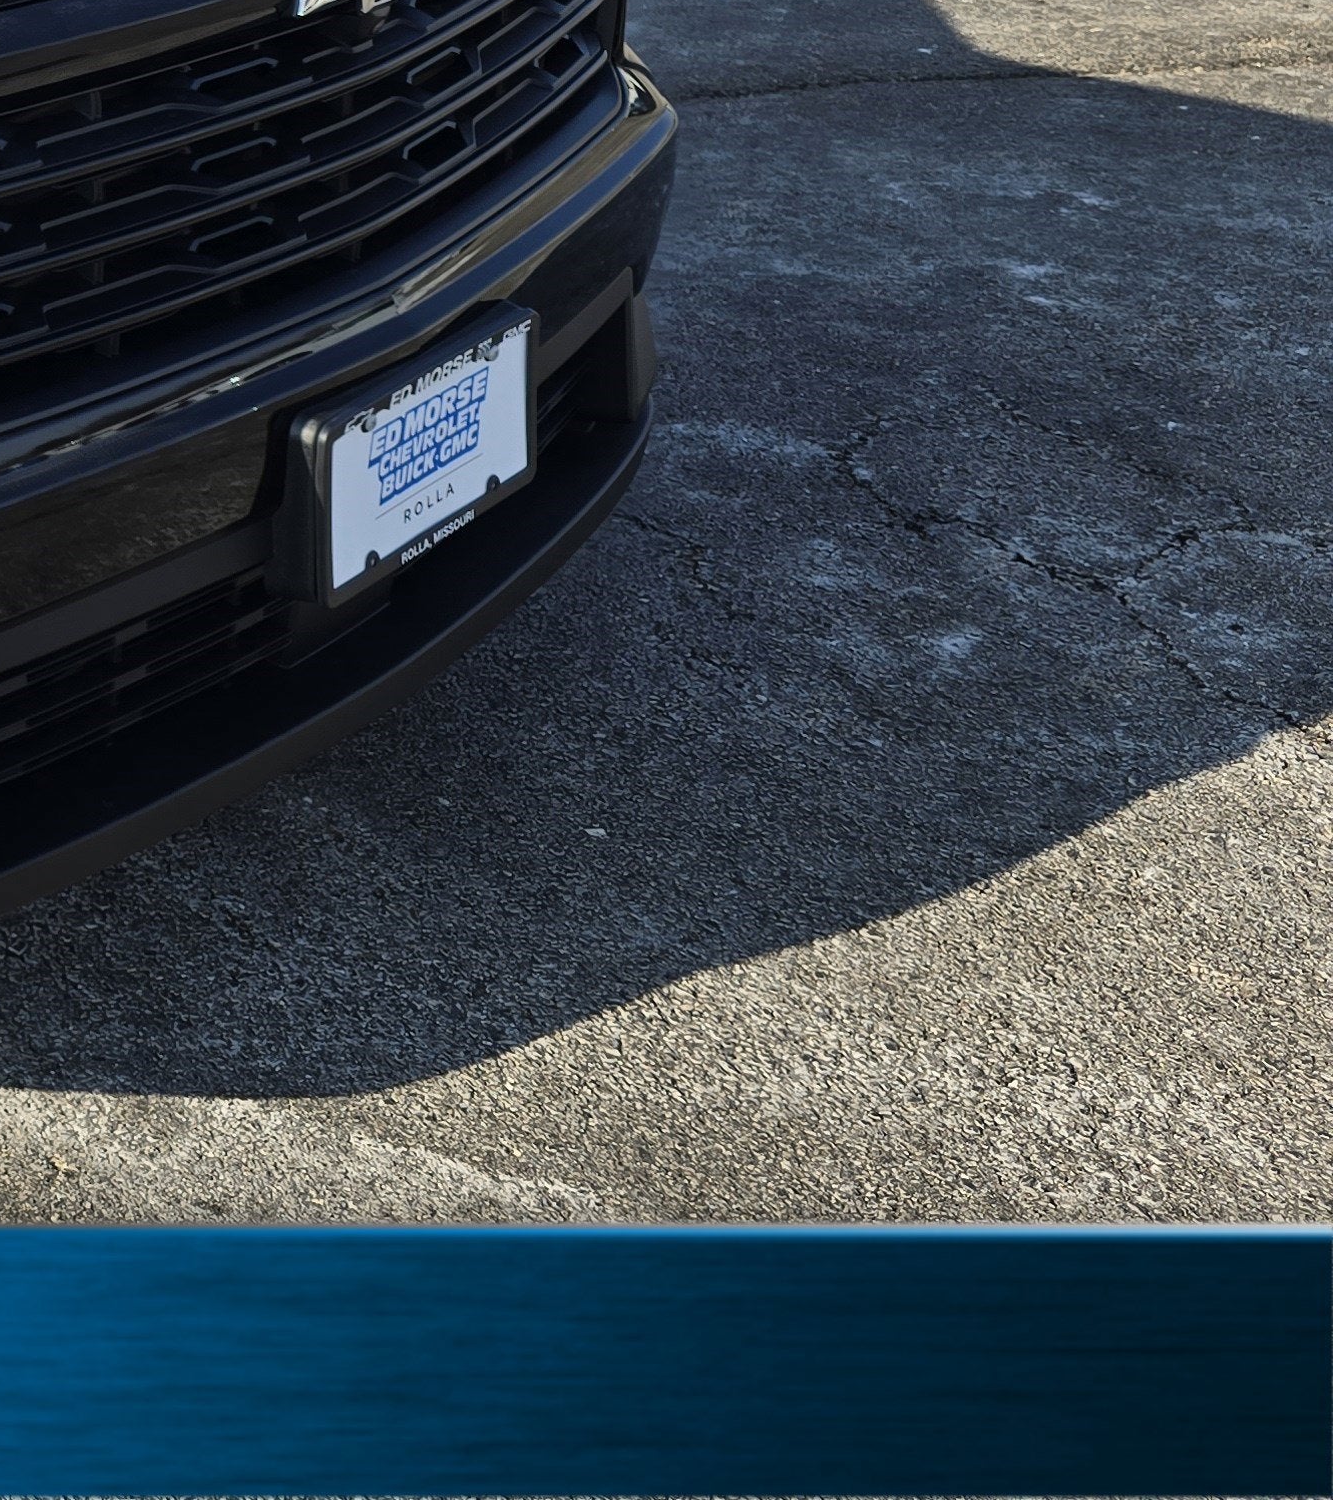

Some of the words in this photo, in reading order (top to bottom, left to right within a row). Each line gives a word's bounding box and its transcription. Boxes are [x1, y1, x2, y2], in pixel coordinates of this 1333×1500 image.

[371, 417, 403, 461] ED
[404, 369, 488, 441] MORSE
[379, 401, 480, 477] CHEVROLET
[403, 482, 455, 524] ROLLA
[433, 508, 476, 544] MISSOURI
